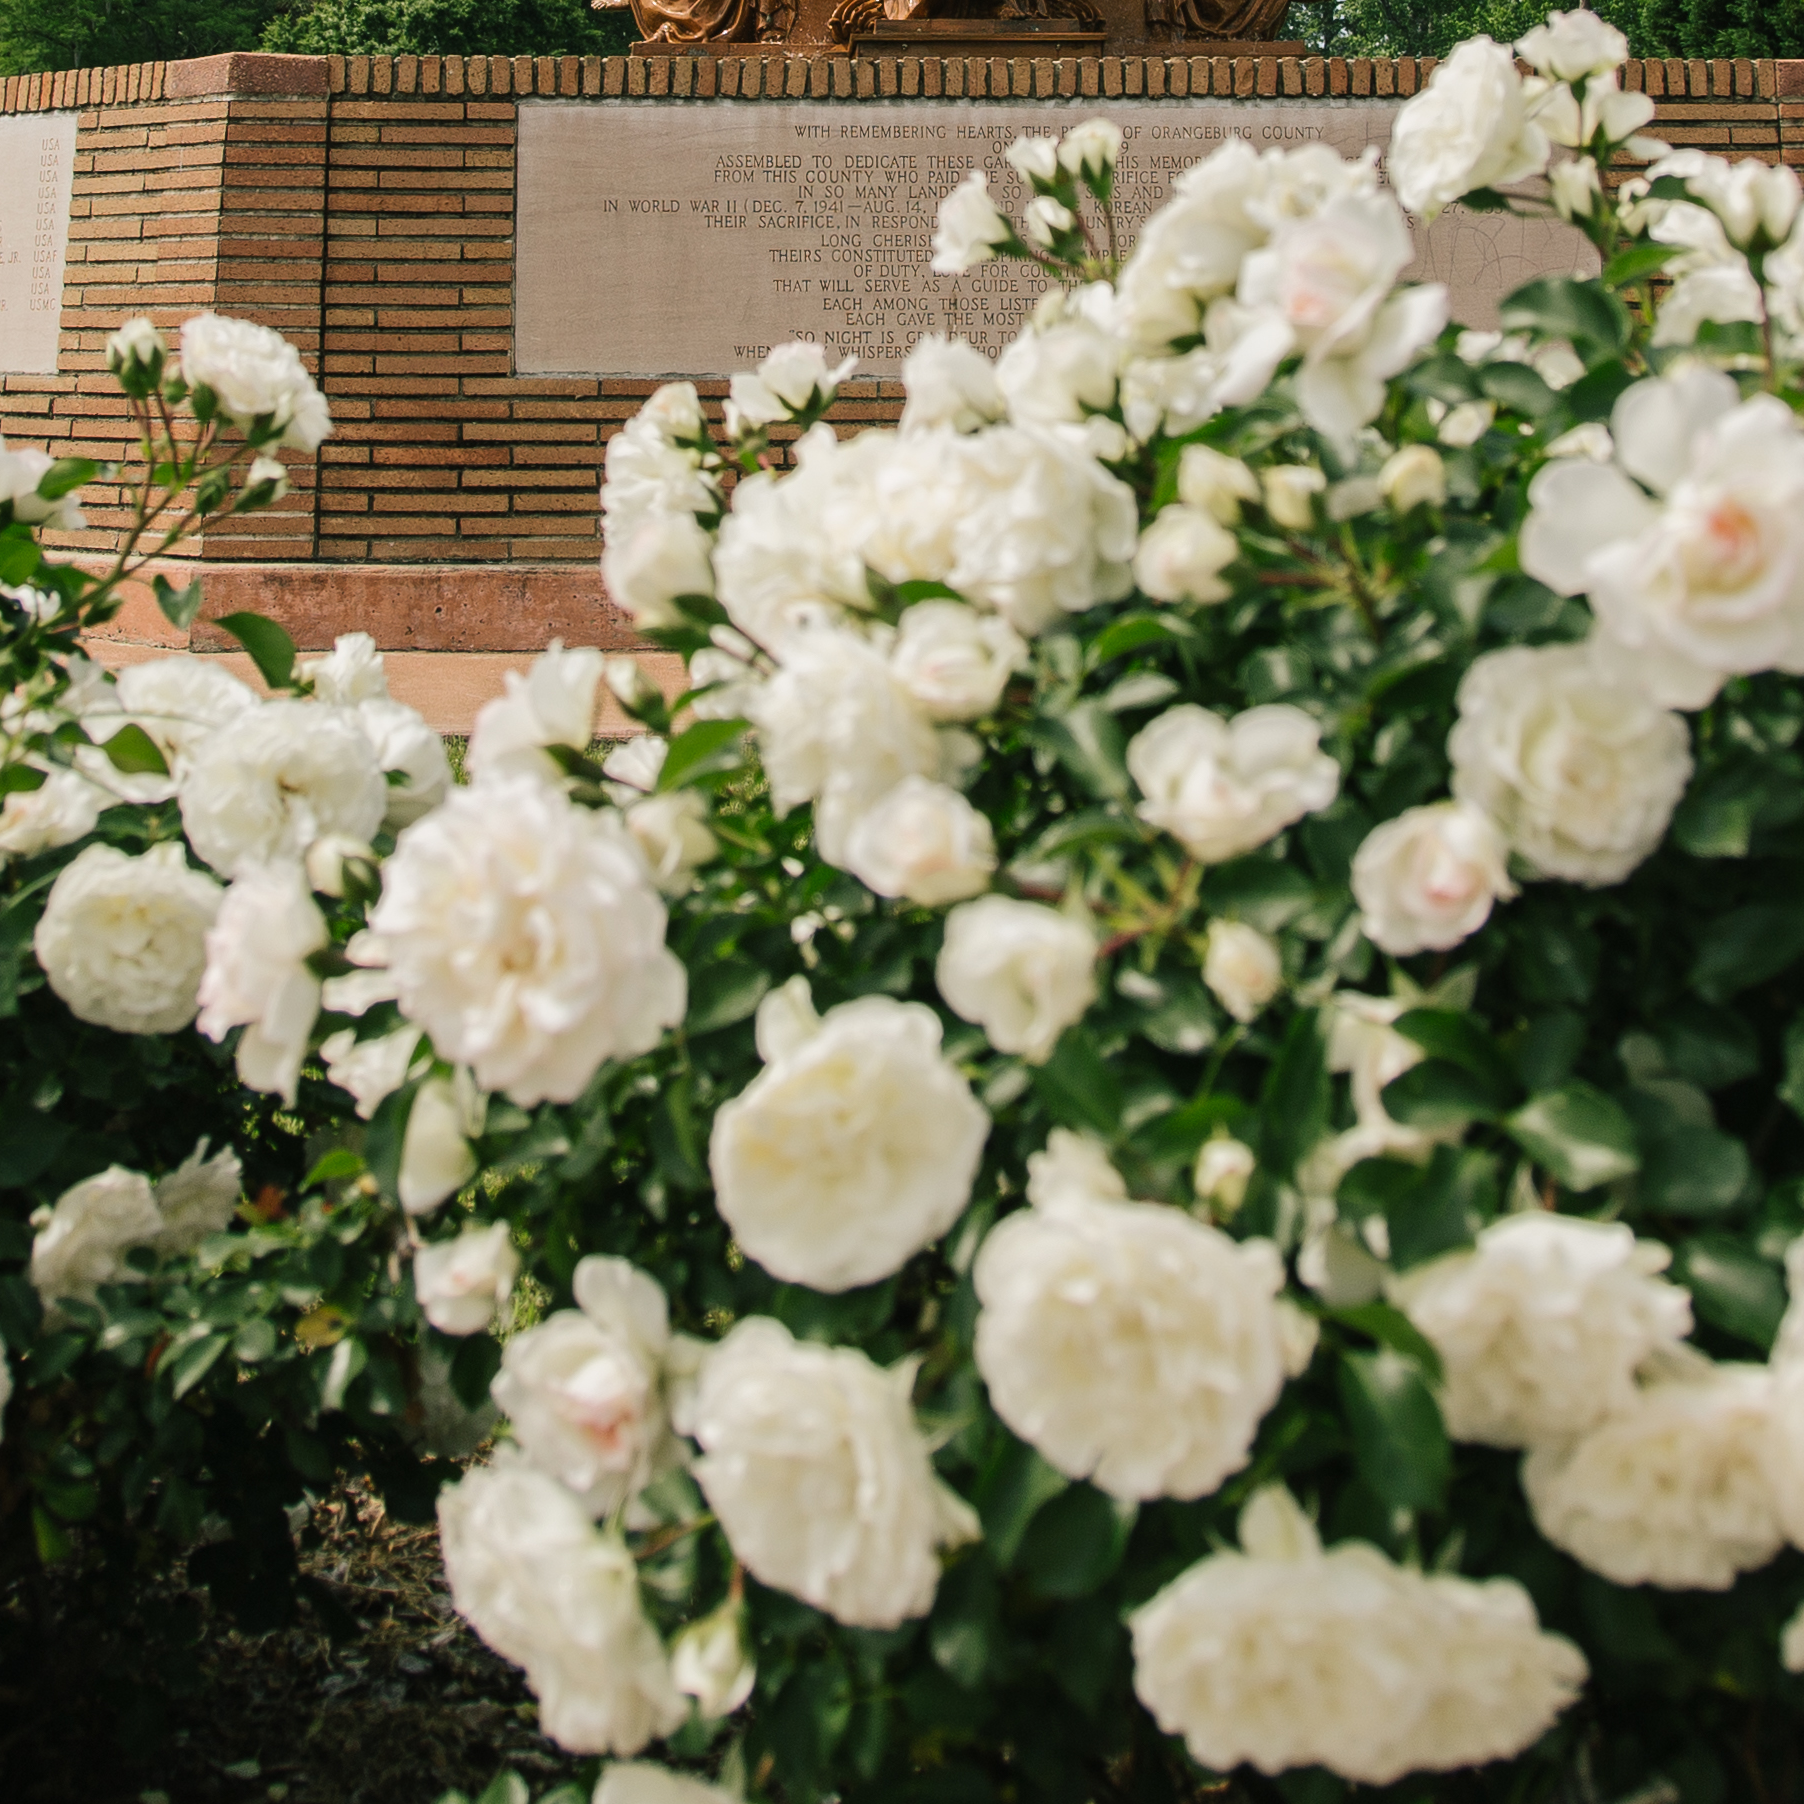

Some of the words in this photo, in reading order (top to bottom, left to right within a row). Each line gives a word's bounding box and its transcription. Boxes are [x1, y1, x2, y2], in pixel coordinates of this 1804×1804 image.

[795, 126, 830, 138] WITH
[840, 126, 946, 138] REMEMBERING
[957, 126, 1017, 139] HEARTS,
[1022, 126, 1050, 138] THE
[1123, 126, 1142, 139] OF
[1151, 126, 1252, 139] ORANGEBURG
[1262, 126, 1324, 140] COUNTY
[42, 138, 59, 151] USA
[41, 155, 58, 166] USA
[716, 155, 801, 168] ASSEMBLED
[812, 156, 832, 168] TO
[845, 156, 917, 168] DEDICATE
[927, 156, 974, 168] THESE
[1116, 156, 1138, 168] HIS
[40, 171, 58, 182] USA
[715, 170, 754, 183] FROM
[763, 170, 796, 183] THIS
[805, 170, 873, 183] COUNTY
[885, 171, 918, 184] WHO
[928, 171, 960, 184] PAID
[38, 187, 56, 198] USA
[799, 186, 813, 198] IN
[825, 186, 844, 199] SO
[856, 186, 897, 198] MANY
[1002, 186, 1021, 199] SO
[1132, 186, 1163, 198] AND
[37, 203, 55, 214] USA
[604, 200, 617, 212] IN
[629, 200, 680, 212] WORLD
[690, 201, 719, 213] WAR
[726, 201, 736, 213] II
[906, 201, 926, 213] 14,
[1094, 201, 1152, 214] KOREAN
[36, 219, 54, 230] USA
[704, 216, 746, 228] THEIR
[759, 216, 840, 229] SACRIFICE,
[846, 216, 860, 229] IN
[35, 235, 52, 246] USA
[821, 234, 861, 247] LONG
[1109, 235, 1136, 247] FOR
[8, 251, 21, 264] JR.
[34, 251, 57, 263] USAF
[769, 250, 821, 262] THEIRS
[831, 249, 933, 262] CONSTITUTED
[32, 267, 50, 279] USA
[854, 265, 873, 277] OF
[880, 265, 925, 278] DUTY,
[981, 265, 1008, 277] FOR
[31, 283, 49, 295] USA
[773, 280, 811, 292] THAT
[820, 280, 854, 292] WILL
[865, 280, 910, 292] SERVE
[922, 280, 940, 293] AS
[952, 280, 961, 292] A
[972, 280, 1017, 292] GUIDE
[1028, 280, 1047, 292] TO
[30, 298, 56, 310] USMC
[824, 298, 862, 310] EACH
[873, 298, 928, 310] AMONG
[939, 298, 989, 310] THOSE
[1000, 299, 1038, 310] LISTE
[846, 313, 885, 325] EACH
[897, 313, 935, 326] GAVE
[945, 313, 974, 325] THE
[983, 313, 1024, 325] MOST
[825, 332, 872, 344] NIGHT
[882, 332, 894, 344] IS
[998, 332, 1017, 344] TO
